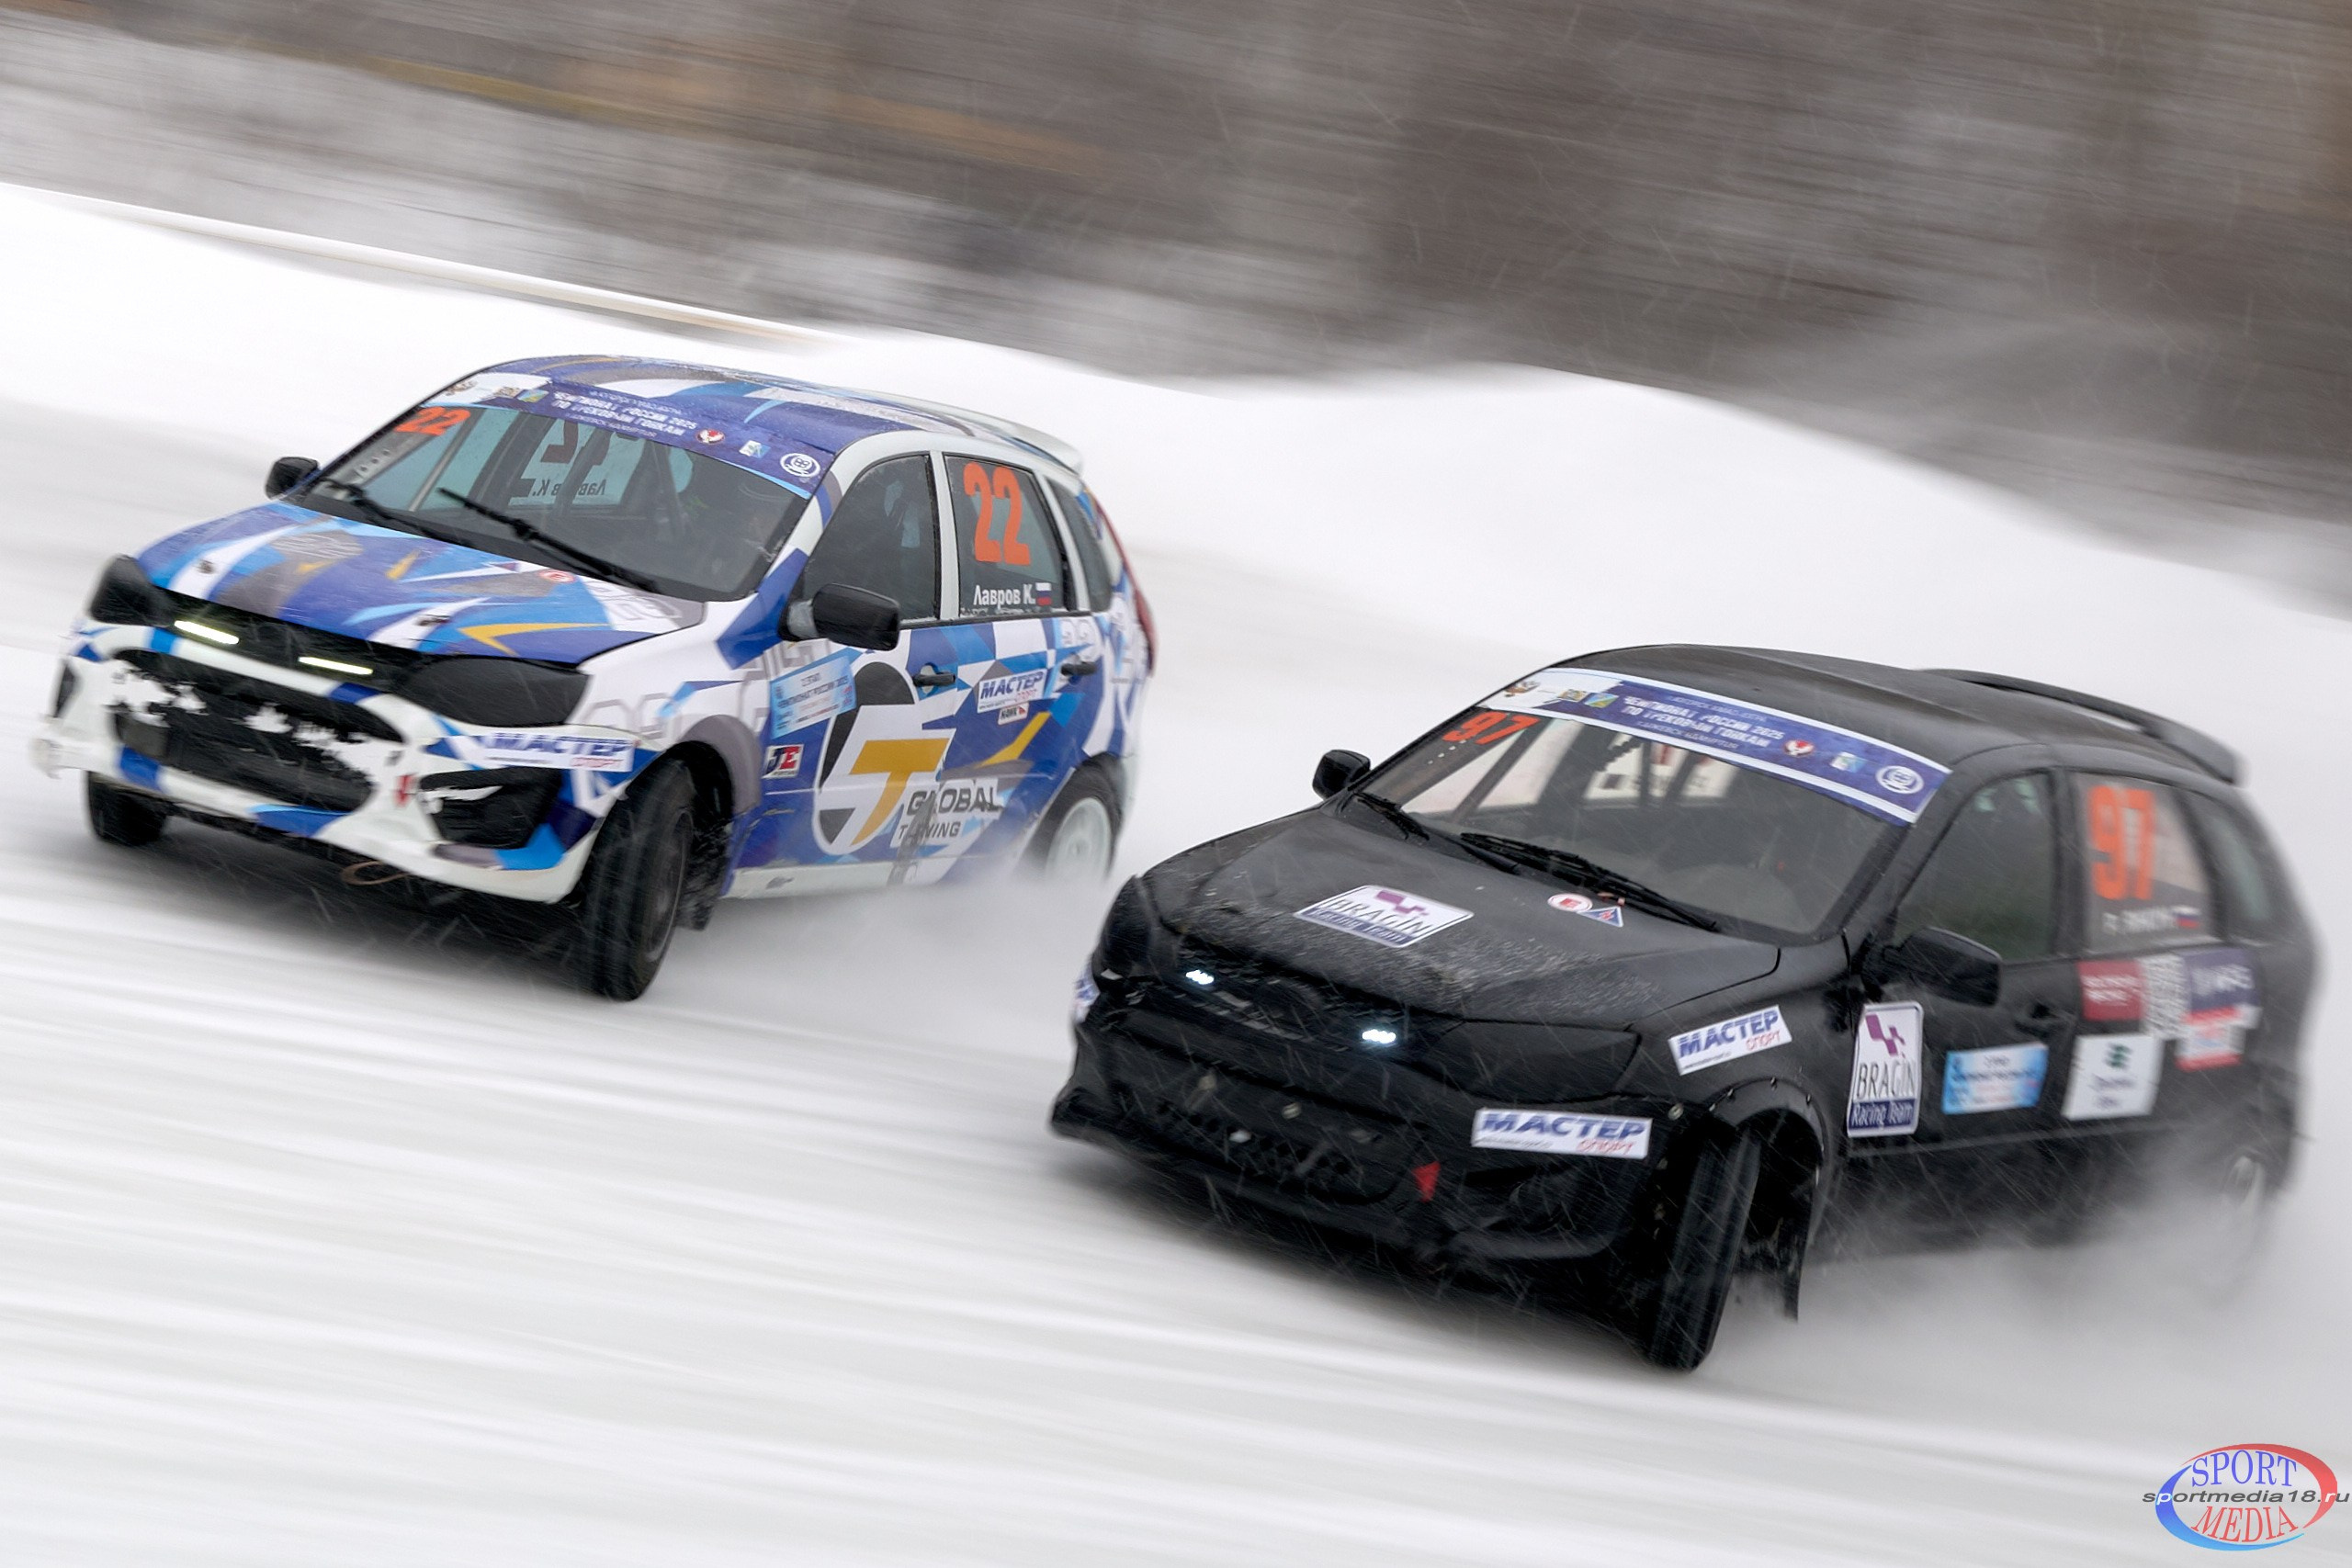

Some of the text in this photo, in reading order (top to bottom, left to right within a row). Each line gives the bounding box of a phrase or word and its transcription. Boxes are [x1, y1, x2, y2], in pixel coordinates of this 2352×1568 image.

[393, 406, 471, 436] 22
[963, 462, 1031, 566] 22
[973, 584, 1021, 610] Лавров
[980, 671, 1044, 699] МАСТЕР
[1442, 711, 1543, 745] 97
[899, 821, 961, 840] TNING
[2087, 785, 2154, 900] 97
[1679, 1010, 1779, 1058] МАСТЕР
[1857, 1061, 1916, 1100] BRAGIN
[1482, 1113, 1645, 1139] МАСТЕР
